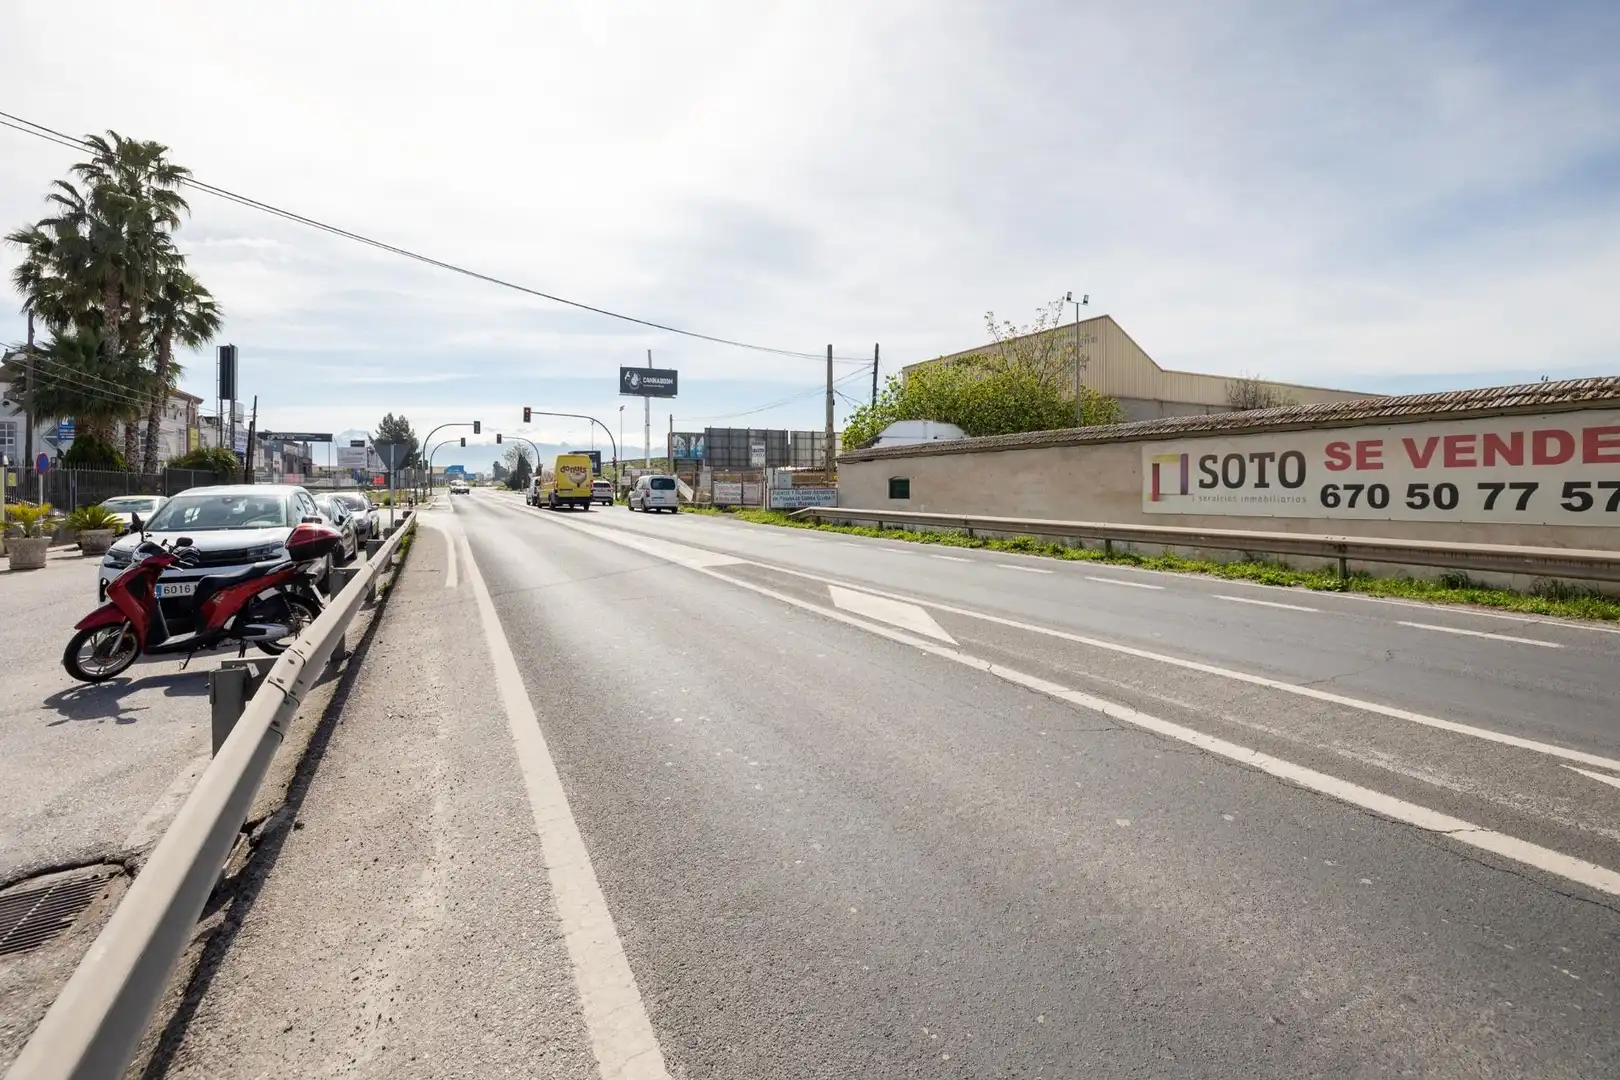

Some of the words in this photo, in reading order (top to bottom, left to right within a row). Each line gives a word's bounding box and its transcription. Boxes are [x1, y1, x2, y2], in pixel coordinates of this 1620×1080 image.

[1324, 440, 1384, 471] SE
[1401, 425, 1620, 469] VENDE
[1198, 450, 1307, 489] SOTO
[1320, 483, 1390, 509] 670
[1405, 482, 1459, 510] 50
[1477, 482, 1539, 511] 77
[1560, 481, 1620, 512] 57
[163, 584, 191, 595] 6016
